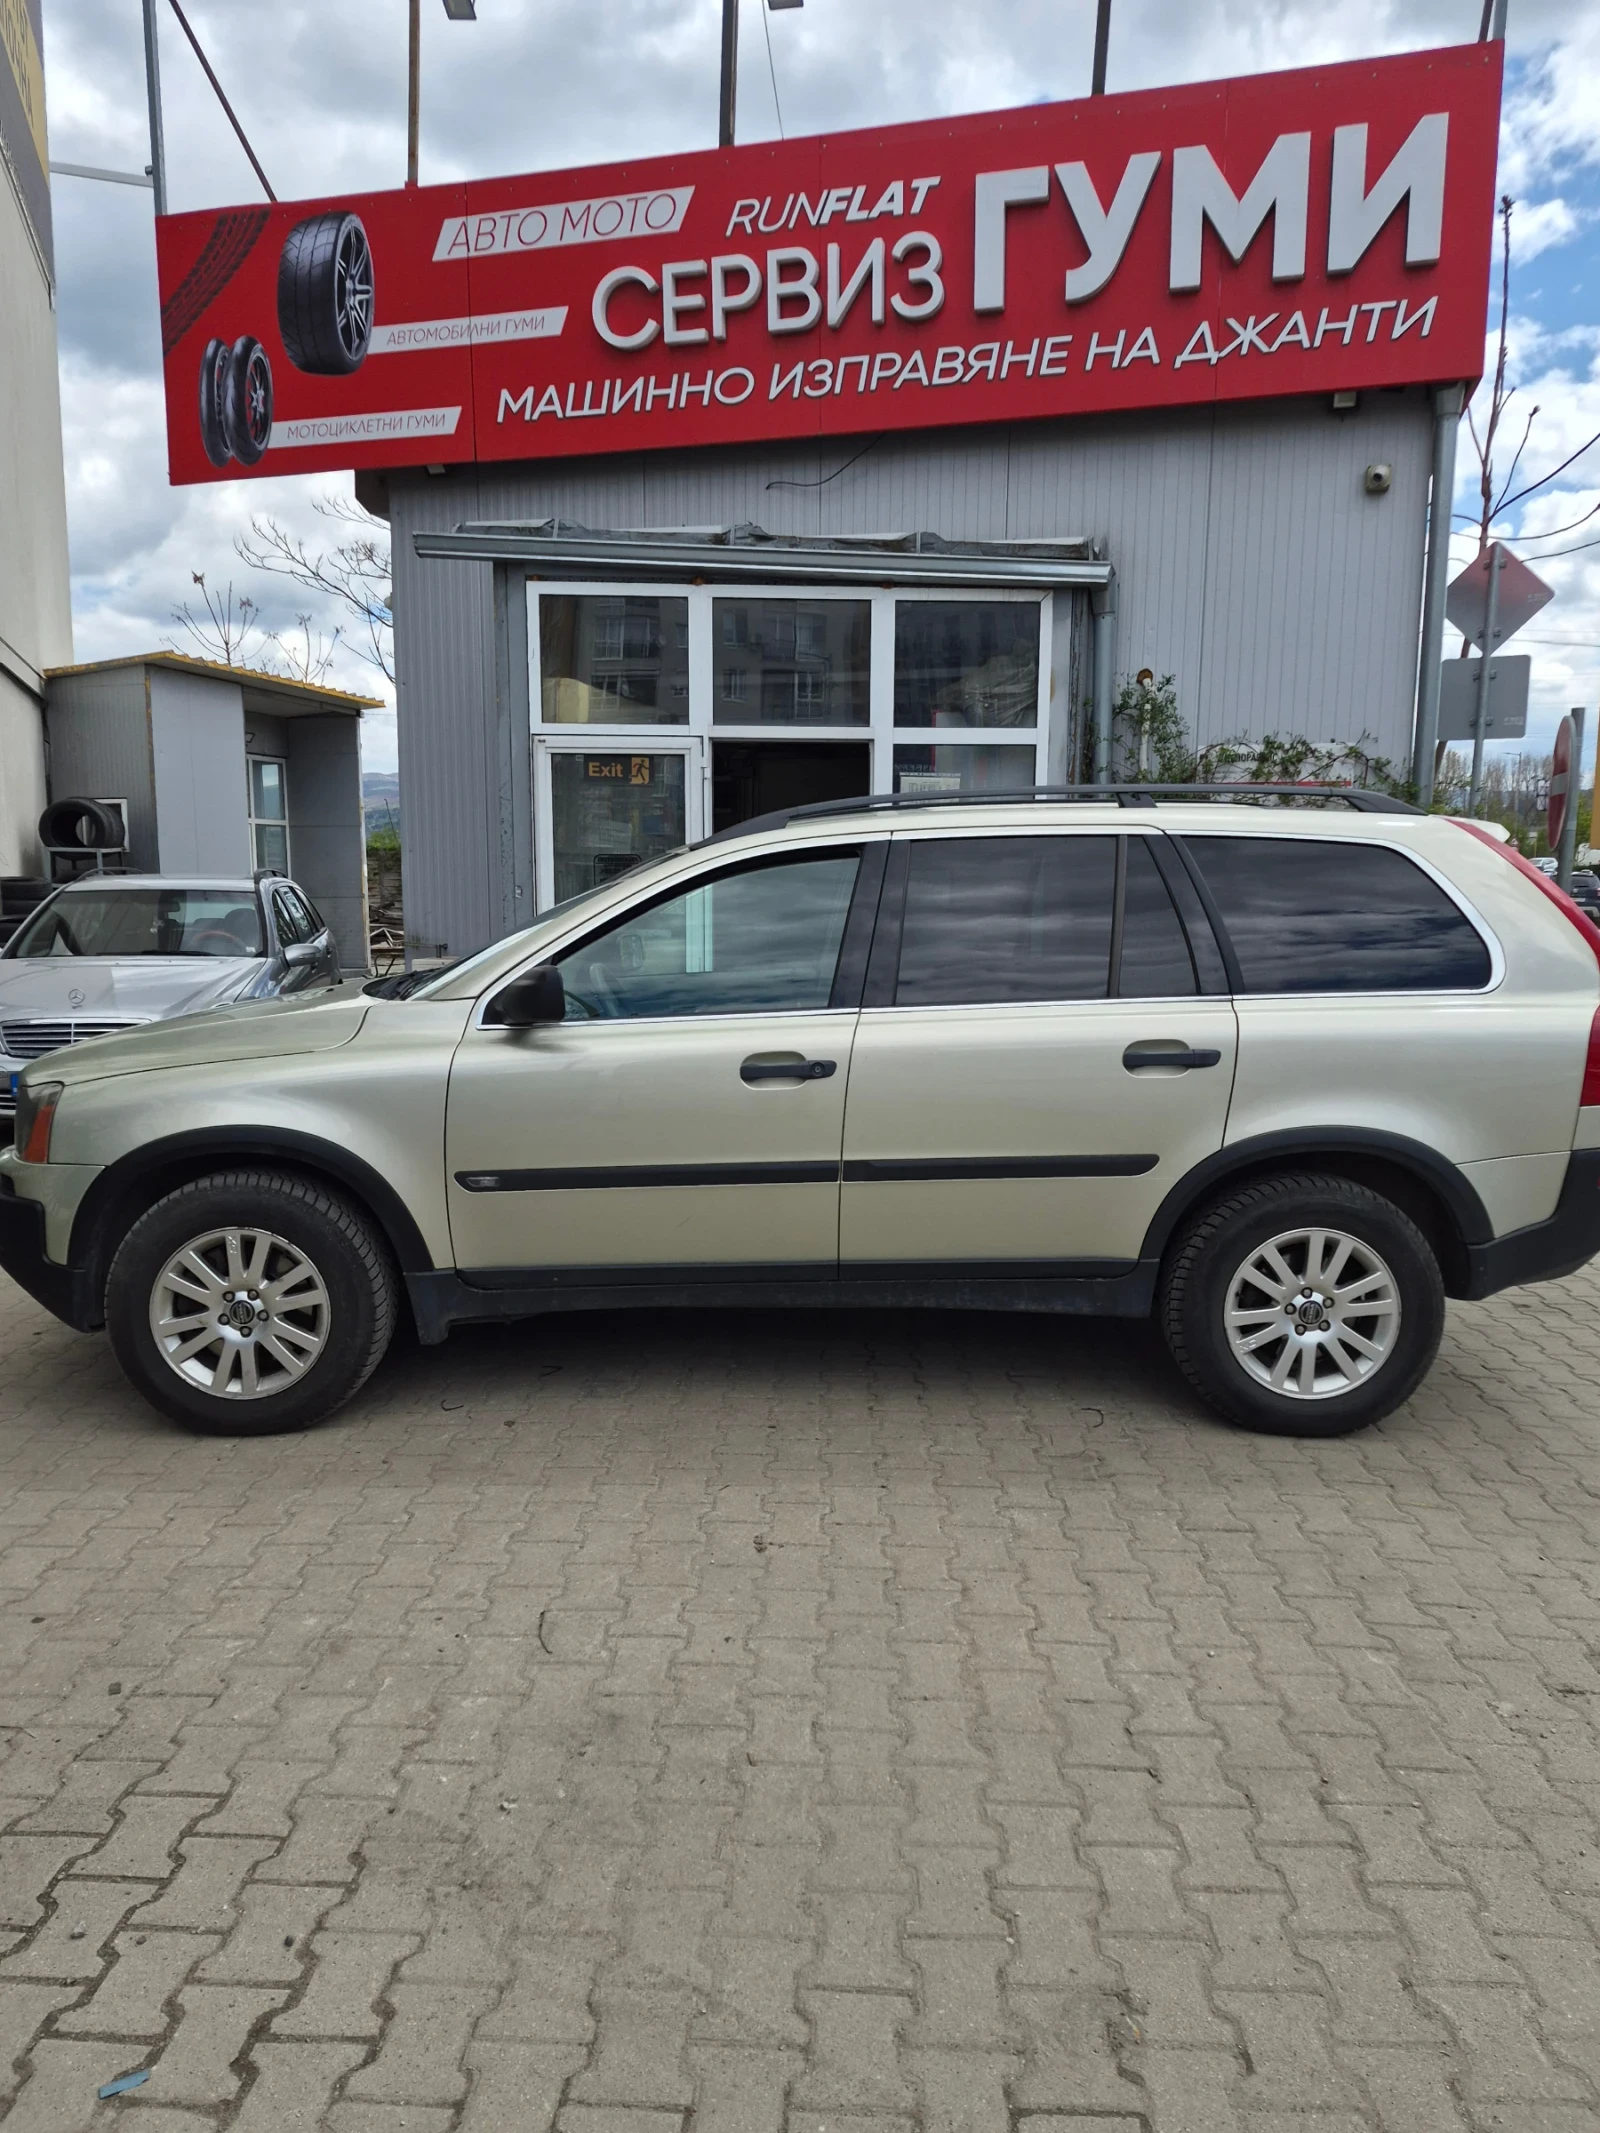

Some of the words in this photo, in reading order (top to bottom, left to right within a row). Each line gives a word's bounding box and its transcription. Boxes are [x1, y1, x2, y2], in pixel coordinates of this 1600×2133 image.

[447, 210, 548, 255] АВТО
[560, 193, 677, 241] МОТО
[592, 230, 945, 350] СЕРВИЗ
[973, 111, 1450, 314] ГУМИ
[725, 176, 942, 237] RUNFLAT
[386, 320, 501, 345] АВТОМОБИЛНИ
[504, 315, 546, 334] ГУМИ
[497, 366, 755, 423] МАШИННО
[768, 334, 1073, 401] ИЗПРАВЯНЕ
[1084, 326, 1161, 371] НА
[1173, 295, 1439, 369] ДЖАНТИ
[287, 417, 403, 440] МОТОЦИКЛЕТНИ
[406, 413, 446, 430] ГУМИ
[588, 761, 624, 778] Exit
